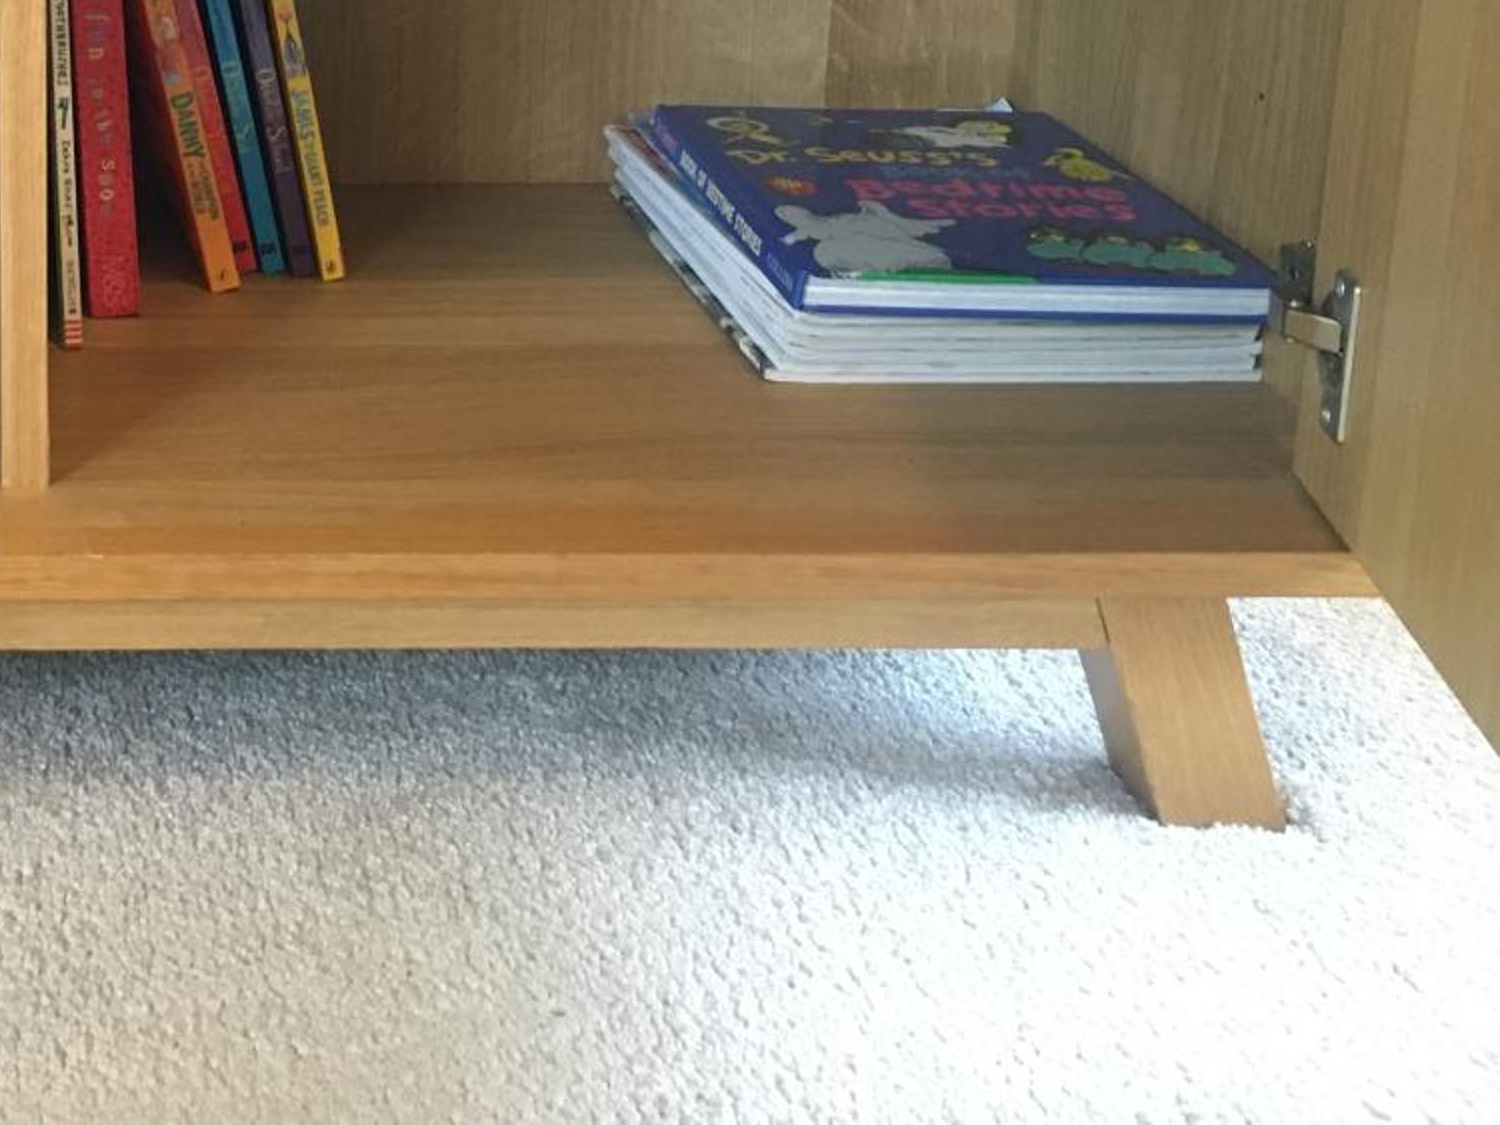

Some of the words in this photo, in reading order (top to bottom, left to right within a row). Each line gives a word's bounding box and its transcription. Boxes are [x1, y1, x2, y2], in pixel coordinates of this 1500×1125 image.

[170, 91, 206, 157] DANNY
[290, 90, 314, 140] JAMES
[725, 148, 799, 165] Dr.
[803, 145, 998, 166] Seuss's
[846, 177, 1127, 202] Bedtime
[906, 196, 1137, 221] Stories
[733, 212, 764, 257] STORIES
